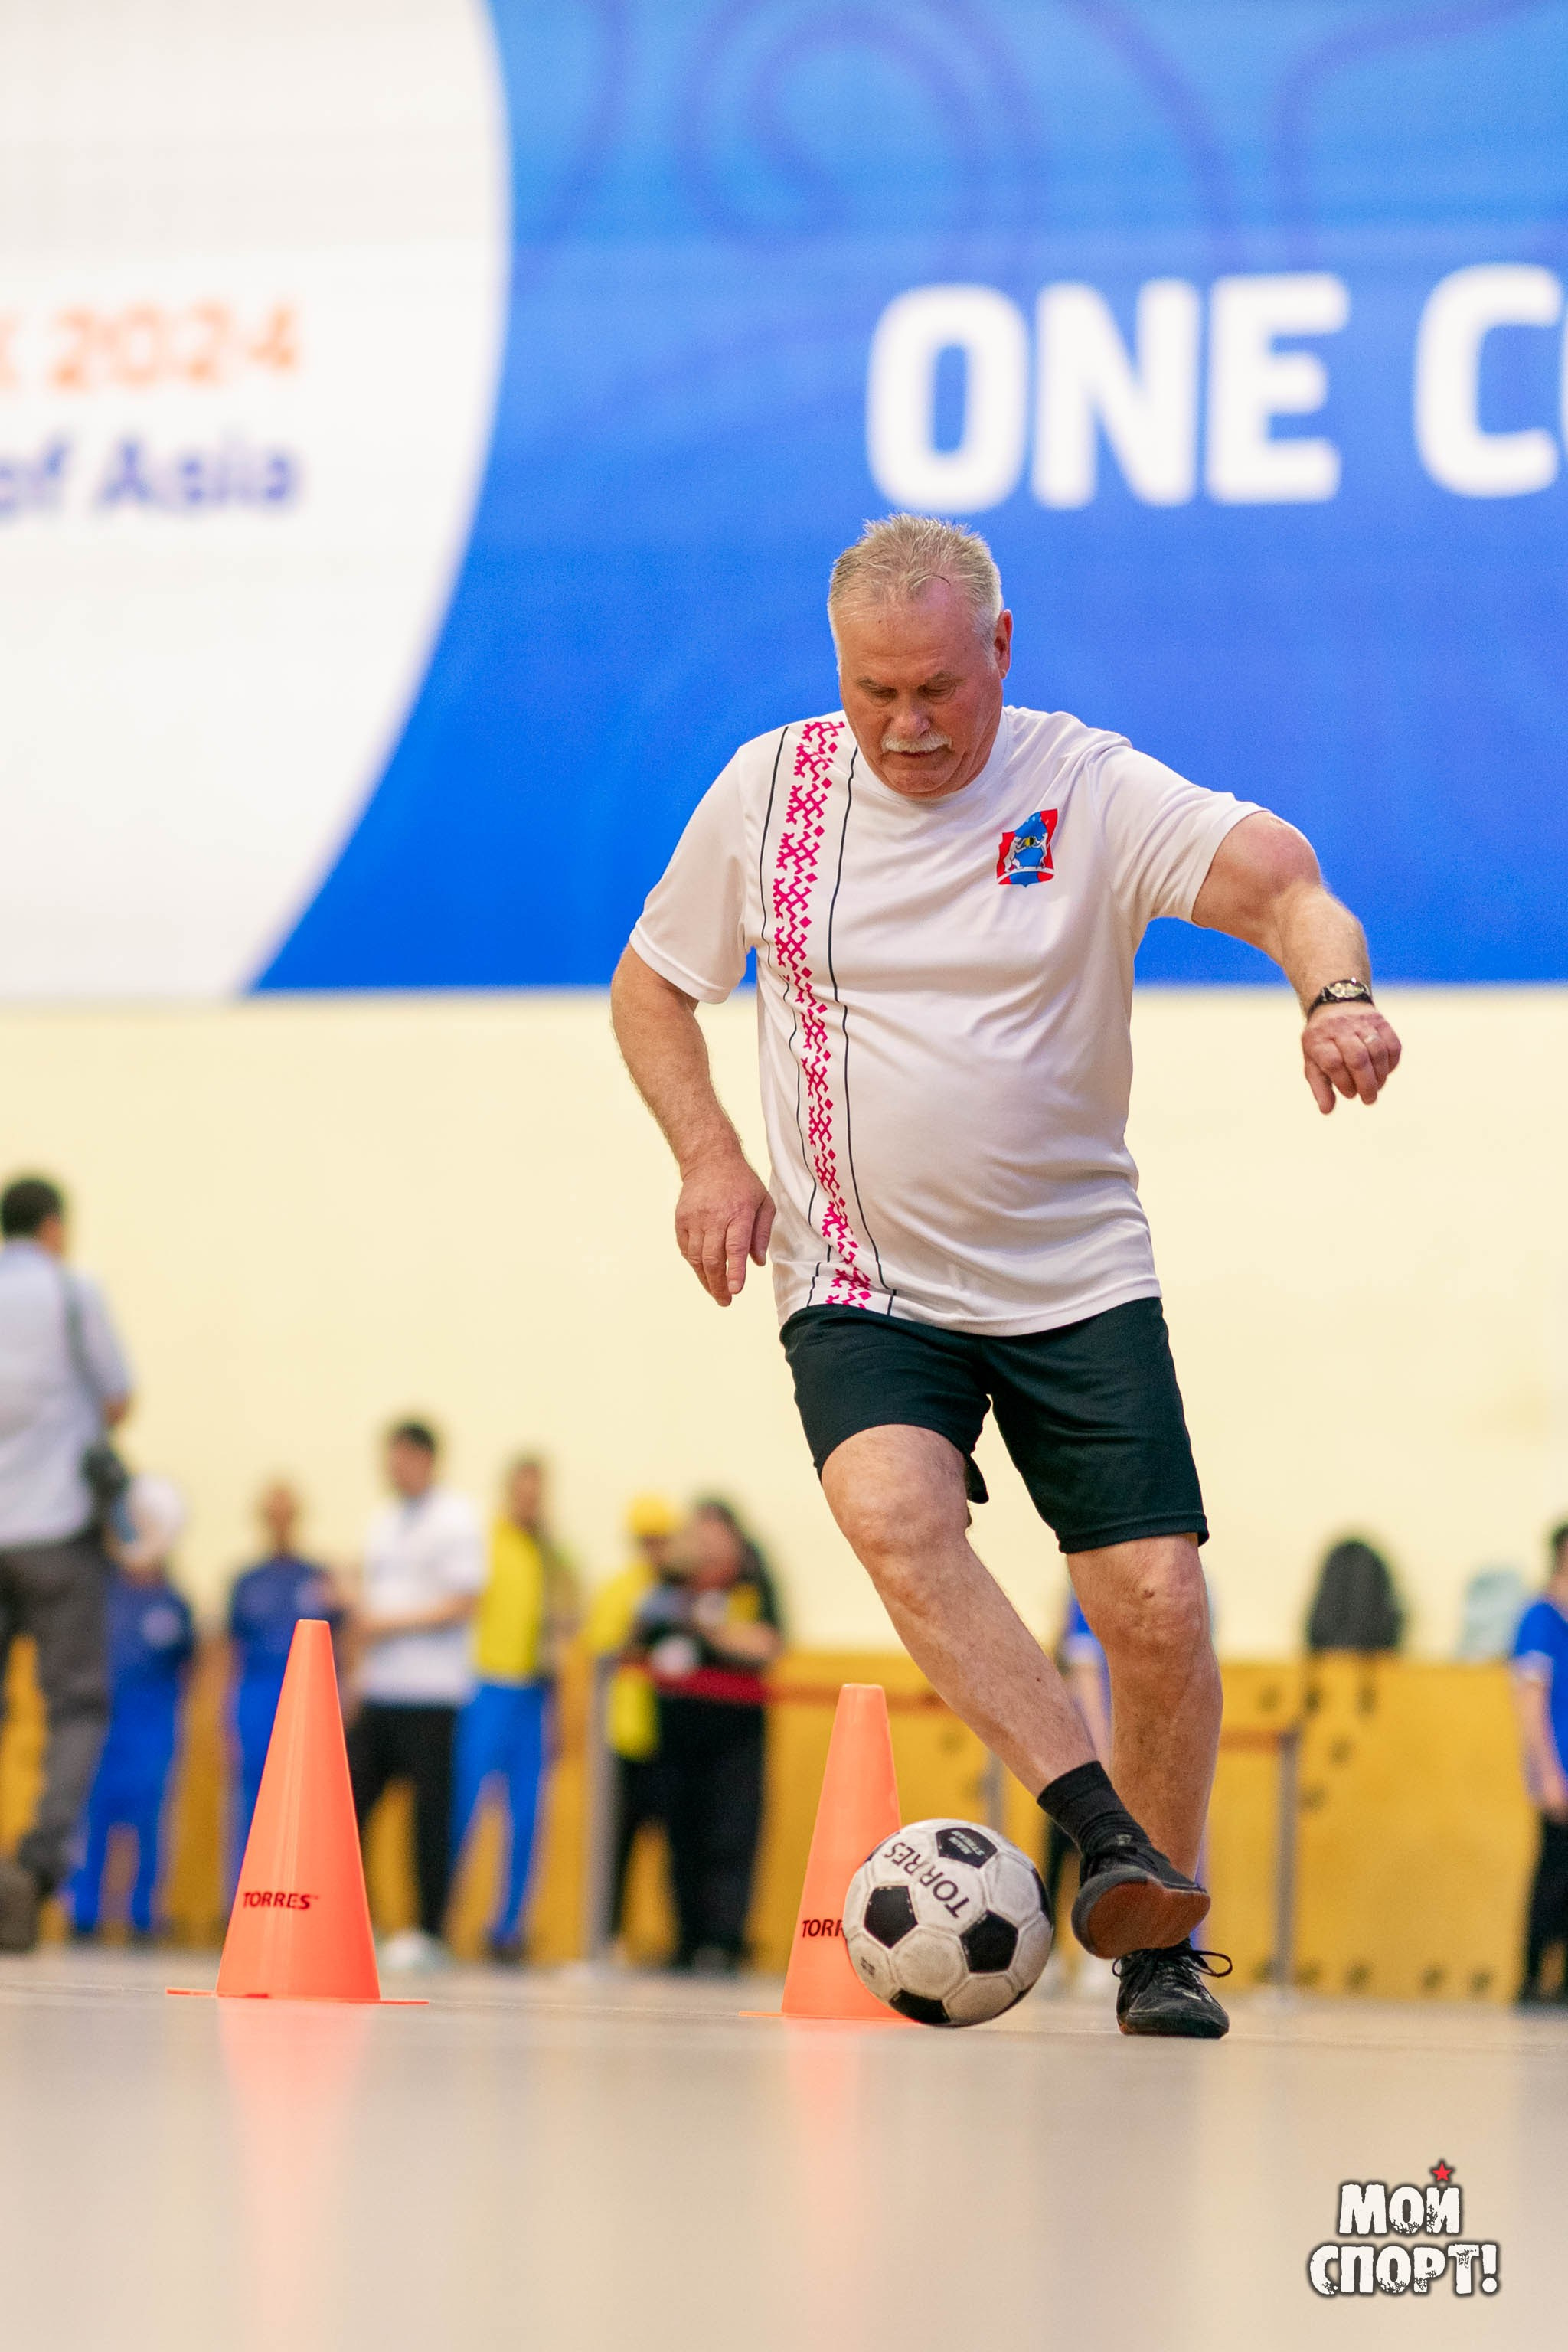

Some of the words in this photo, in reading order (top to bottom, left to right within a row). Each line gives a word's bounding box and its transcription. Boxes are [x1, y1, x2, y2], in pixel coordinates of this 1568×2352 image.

[54, 299, 302, 394] 2024
[867, 273, 1348, 512] ONE
[1413, 263, 1568, 499] C
[93, 430, 303, 516] Asia
[243, 1891, 311, 1911] TORRES
[884, 1842, 969, 1918] TORRES
[802, 1919, 844, 1938] TORR
